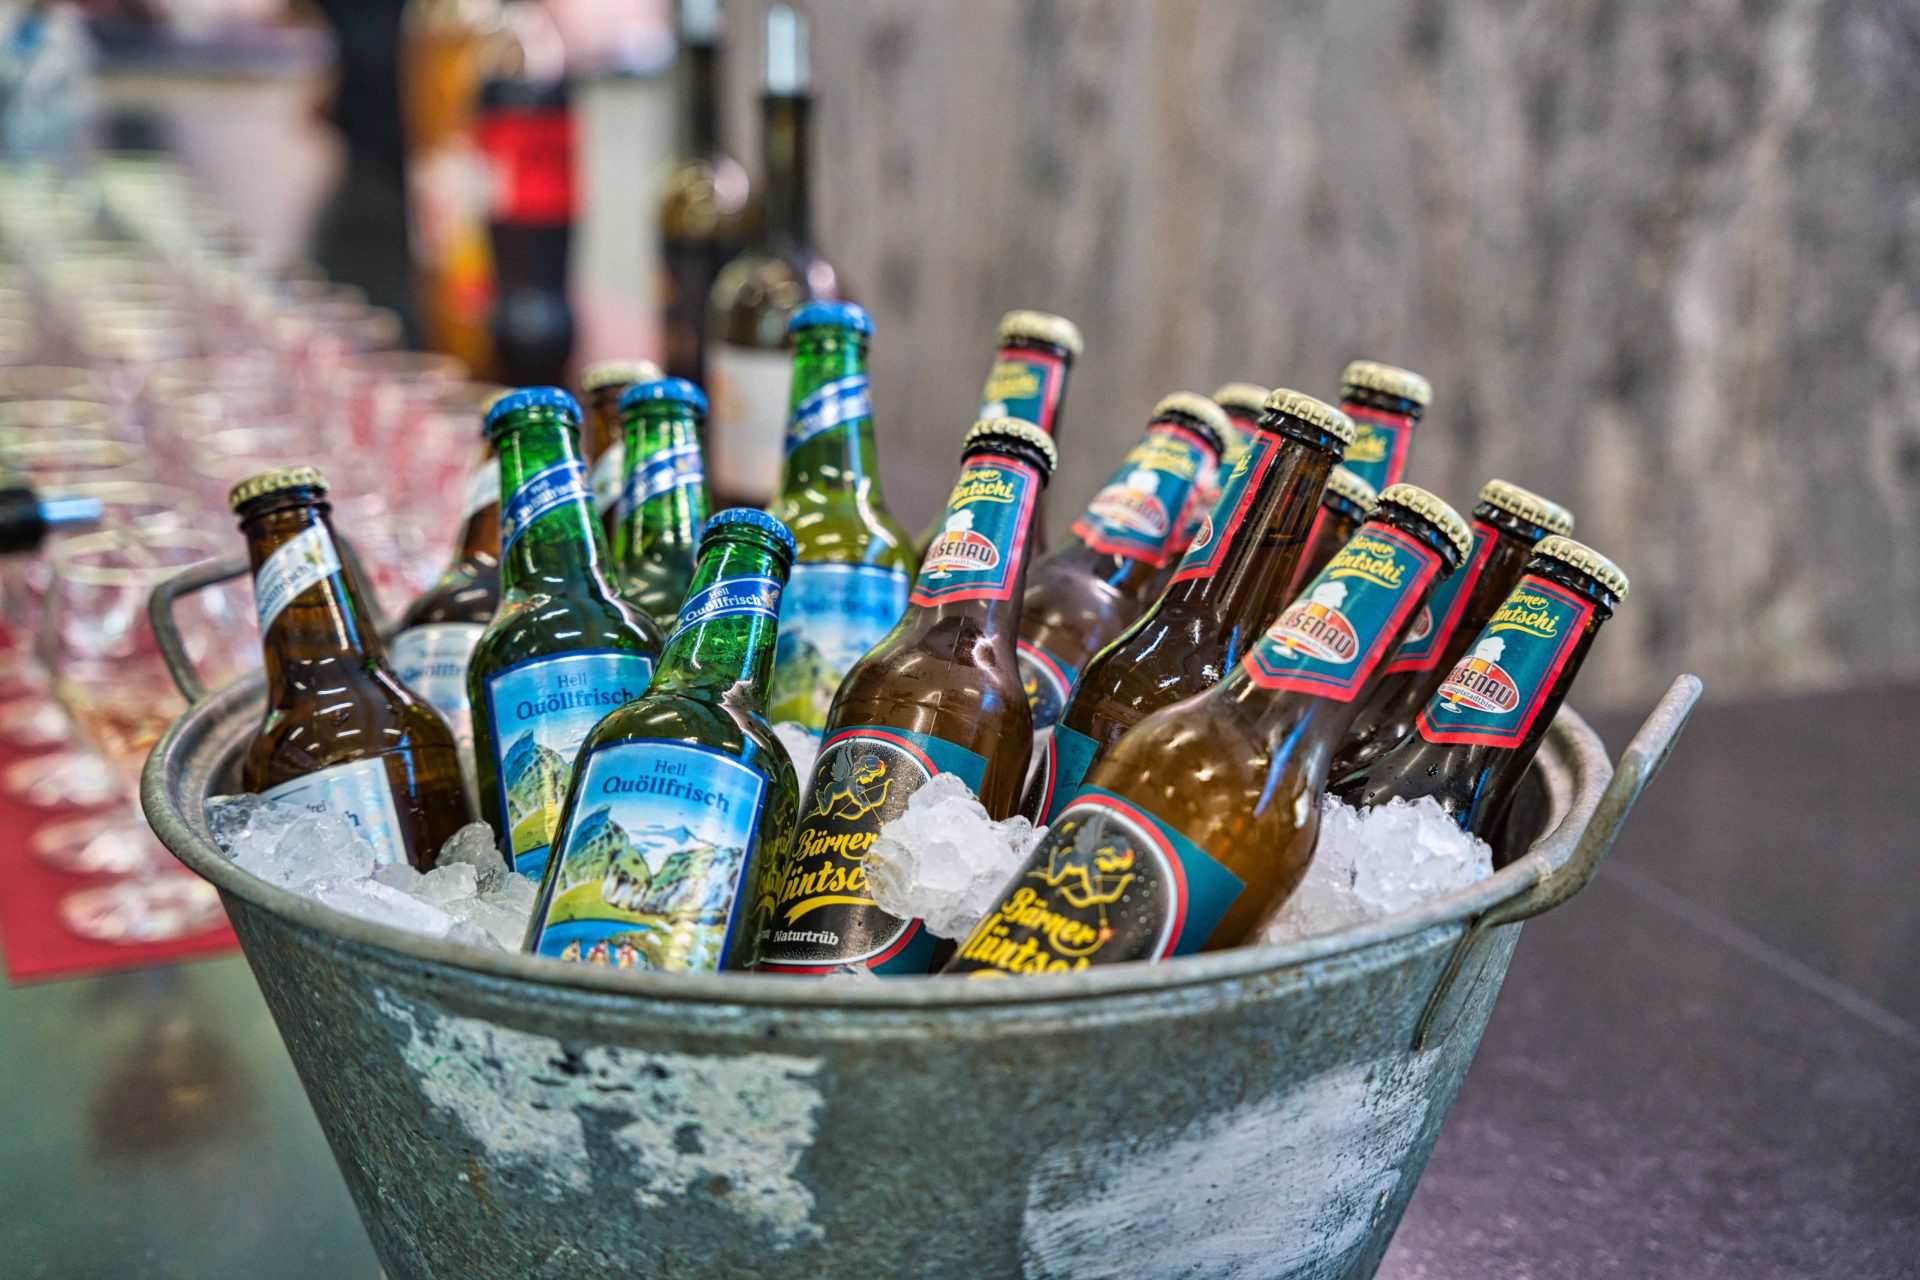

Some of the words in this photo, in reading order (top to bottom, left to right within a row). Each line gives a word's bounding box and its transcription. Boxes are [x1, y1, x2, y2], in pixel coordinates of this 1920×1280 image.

[556, 672, 588, 689] Hell
[516, 687, 634, 721] Quöllfrisch
[653, 759, 688, 777] Hell
[602, 775, 731, 814] Quöllfrisch
[791, 828, 878, 862] Bärner
[772, 929, 840, 946] Naturtrüb
[1001, 886, 1101, 957] Bärner
